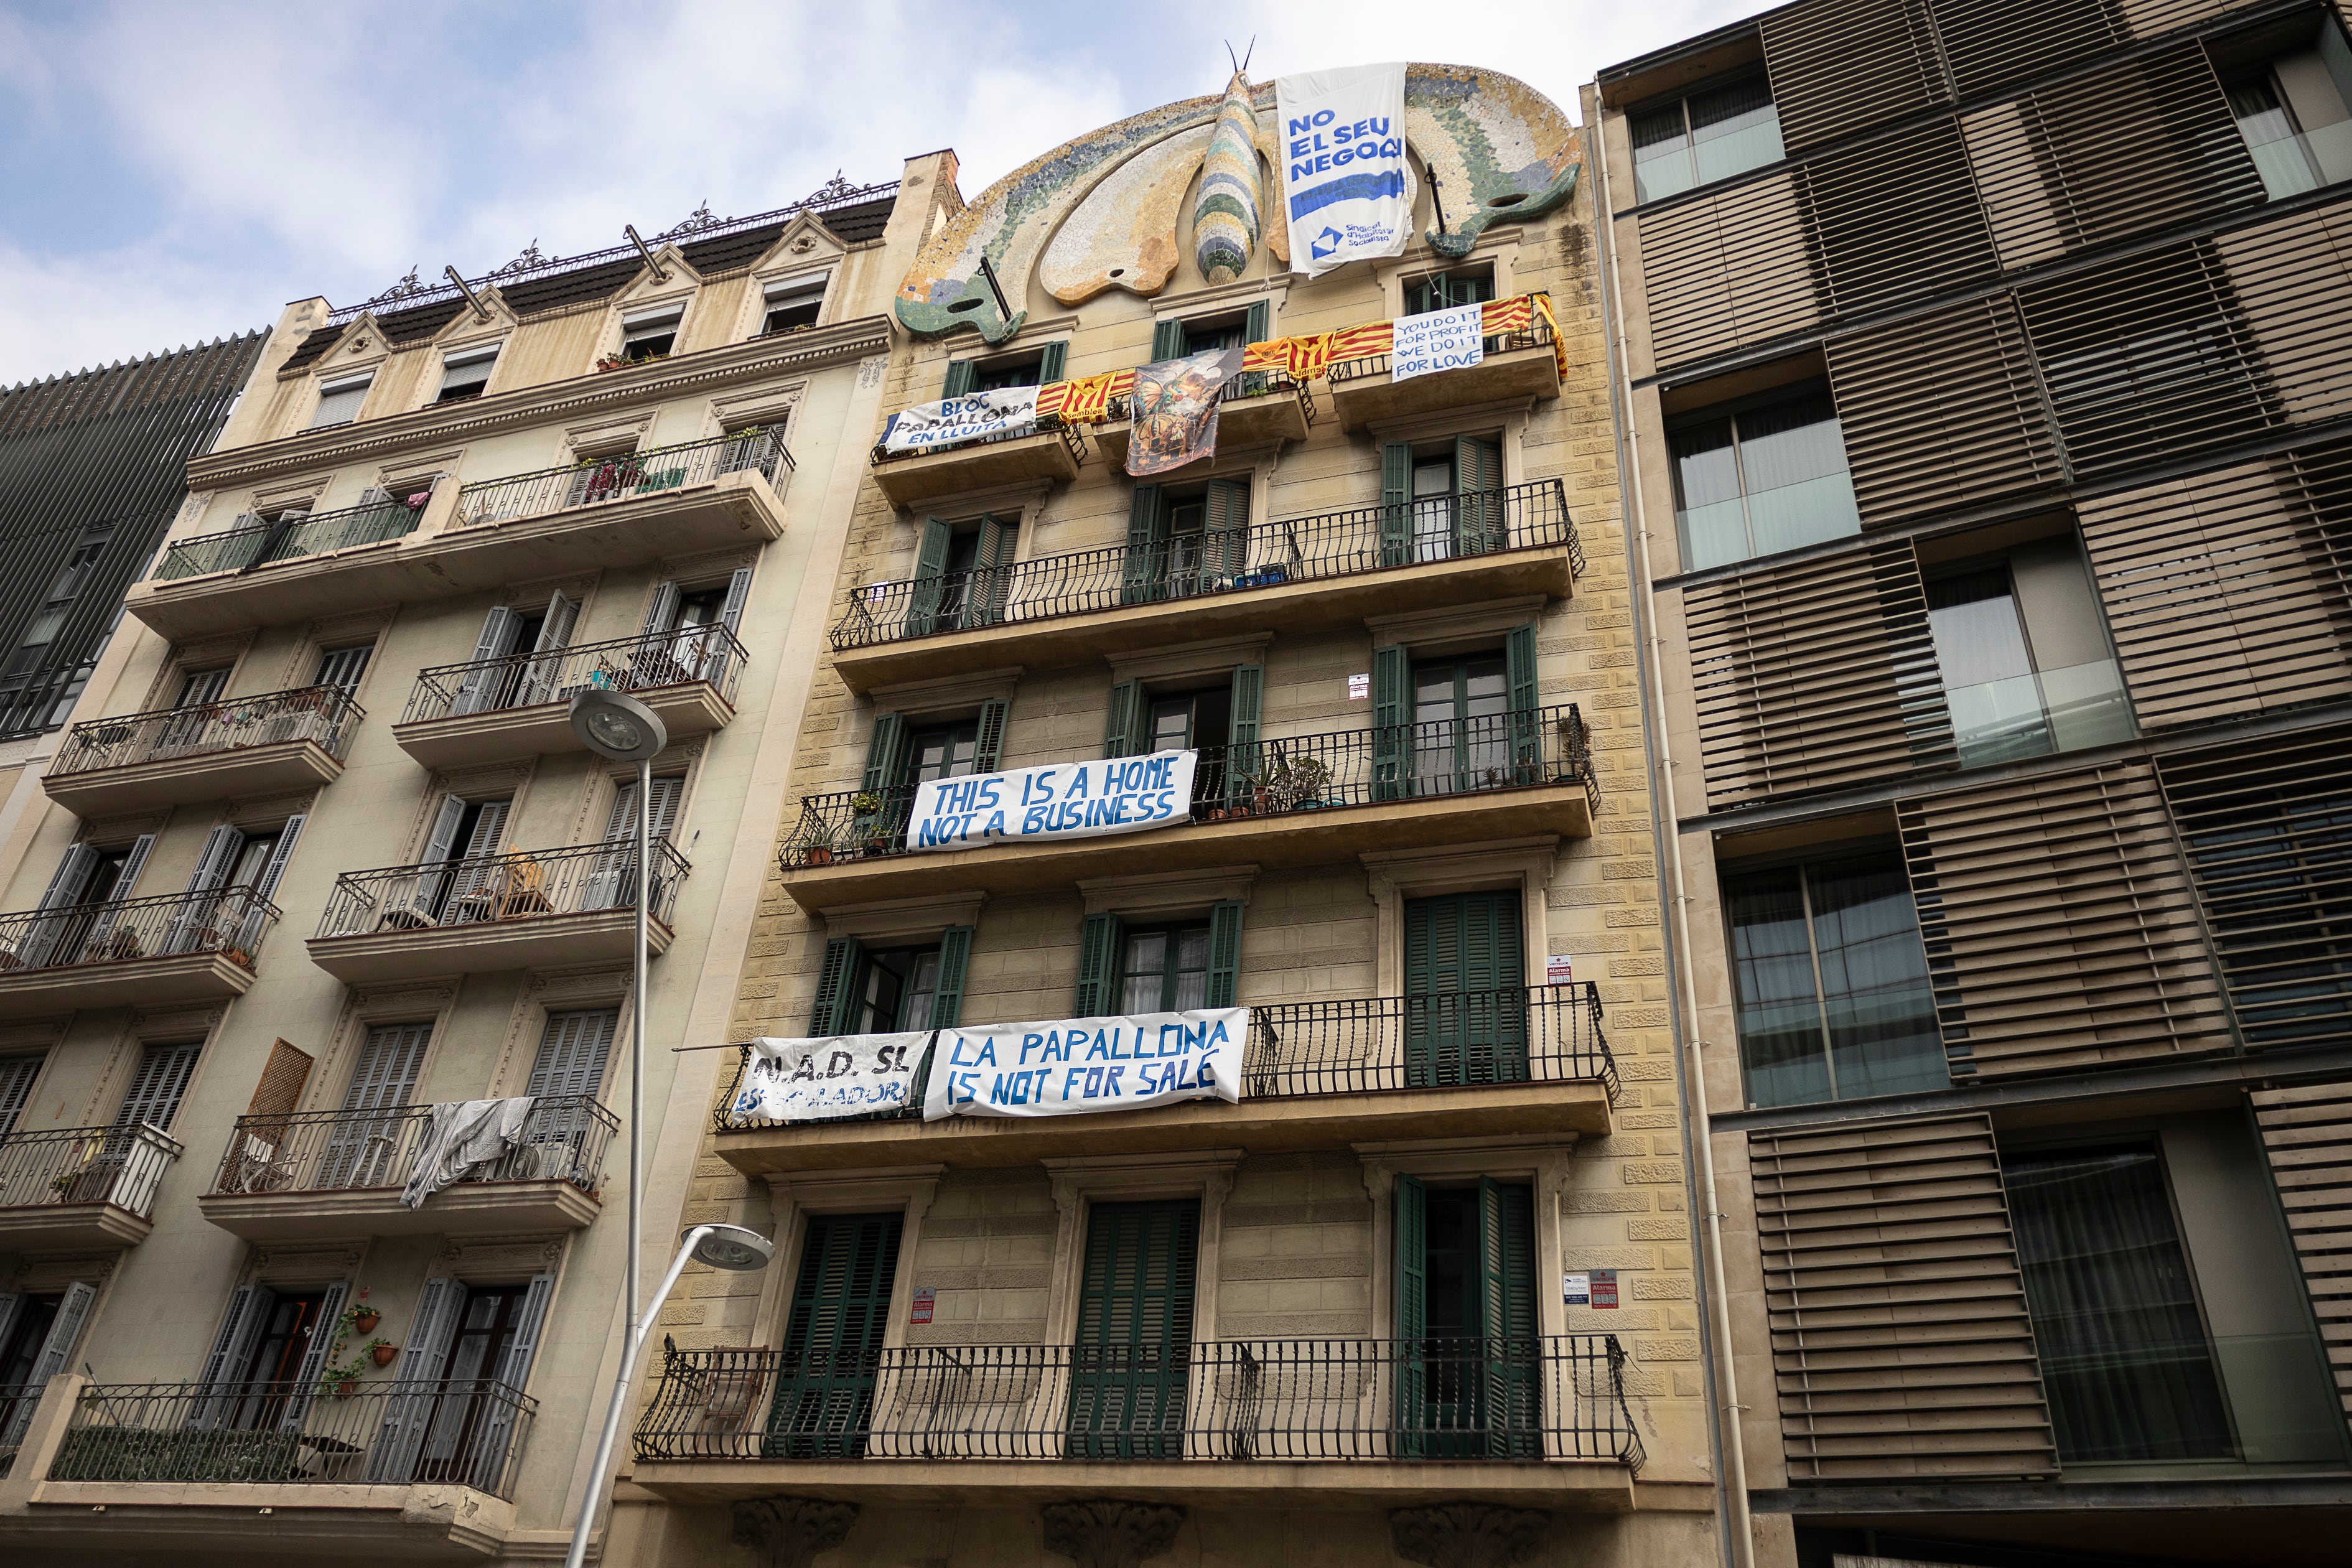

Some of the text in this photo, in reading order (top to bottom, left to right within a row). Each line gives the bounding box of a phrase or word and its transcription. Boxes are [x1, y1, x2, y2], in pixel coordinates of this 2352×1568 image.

[1289, 109, 1335, 136] NO
[1290, 117, 1389, 159] EL SEU
[1396, 322, 1481, 347] FOR PROFIT
[1398, 310, 1480, 336] YOU DO IT
[1397, 335, 1480, 357] WE DO IT
[1396, 349, 1482, 377] FOR LOVE
[941, 393, 989, 418] BLOC
[908, 420, 1007, 444] EN LLUITA
[935, 757, 1178, 816] THIS IS A HOME
[918, 790, 1175, 848] NOT A BUSINESS
[949, 1020, 1230, 1067] LA PAPALLONA
[948, 1049, 1220, 1106] IS NOT FOR SALE
